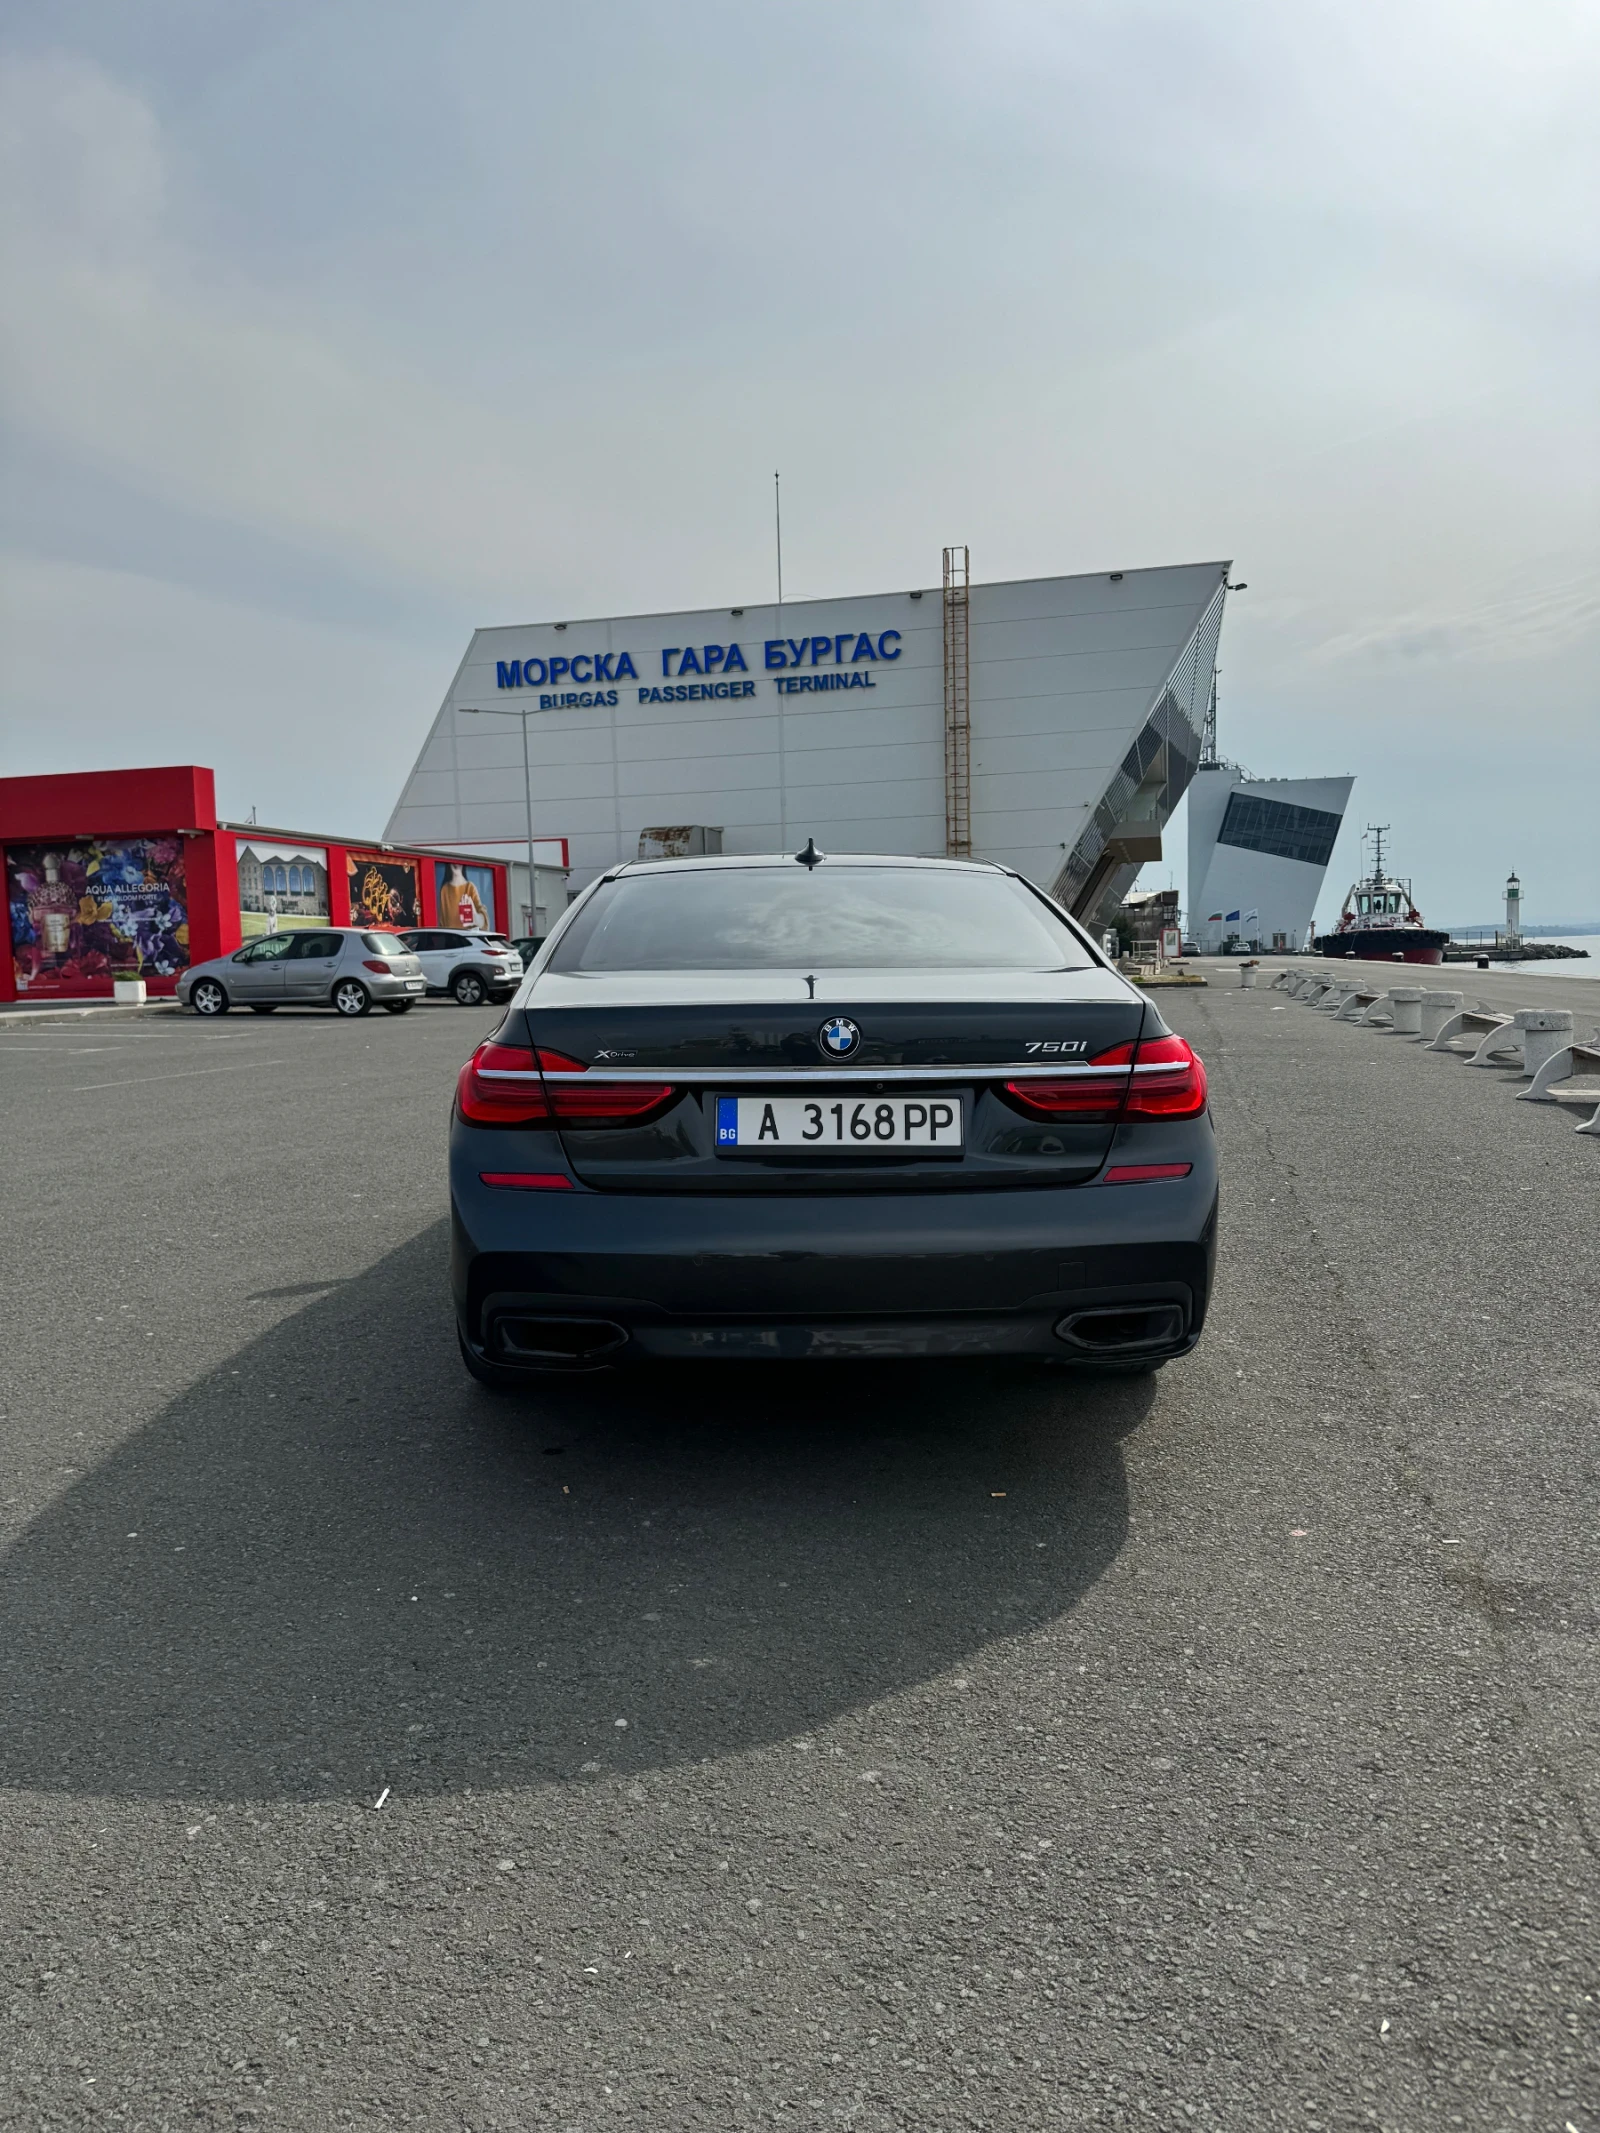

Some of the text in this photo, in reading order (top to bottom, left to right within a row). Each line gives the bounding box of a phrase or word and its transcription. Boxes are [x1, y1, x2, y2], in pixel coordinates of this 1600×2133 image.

[496, 630, 902, 689] МОРСКА ГАРА БУРГАС
[540, 671, 876, 710] BURGAS PASSENGER TERMINAL
[85, 883, 170, 895] AQUA ALLEGORIA
[824, 1019, 857, 1032] BMW
[719, 1128, 736, 1140] BG
[758, 1103, 780, 1140] A
